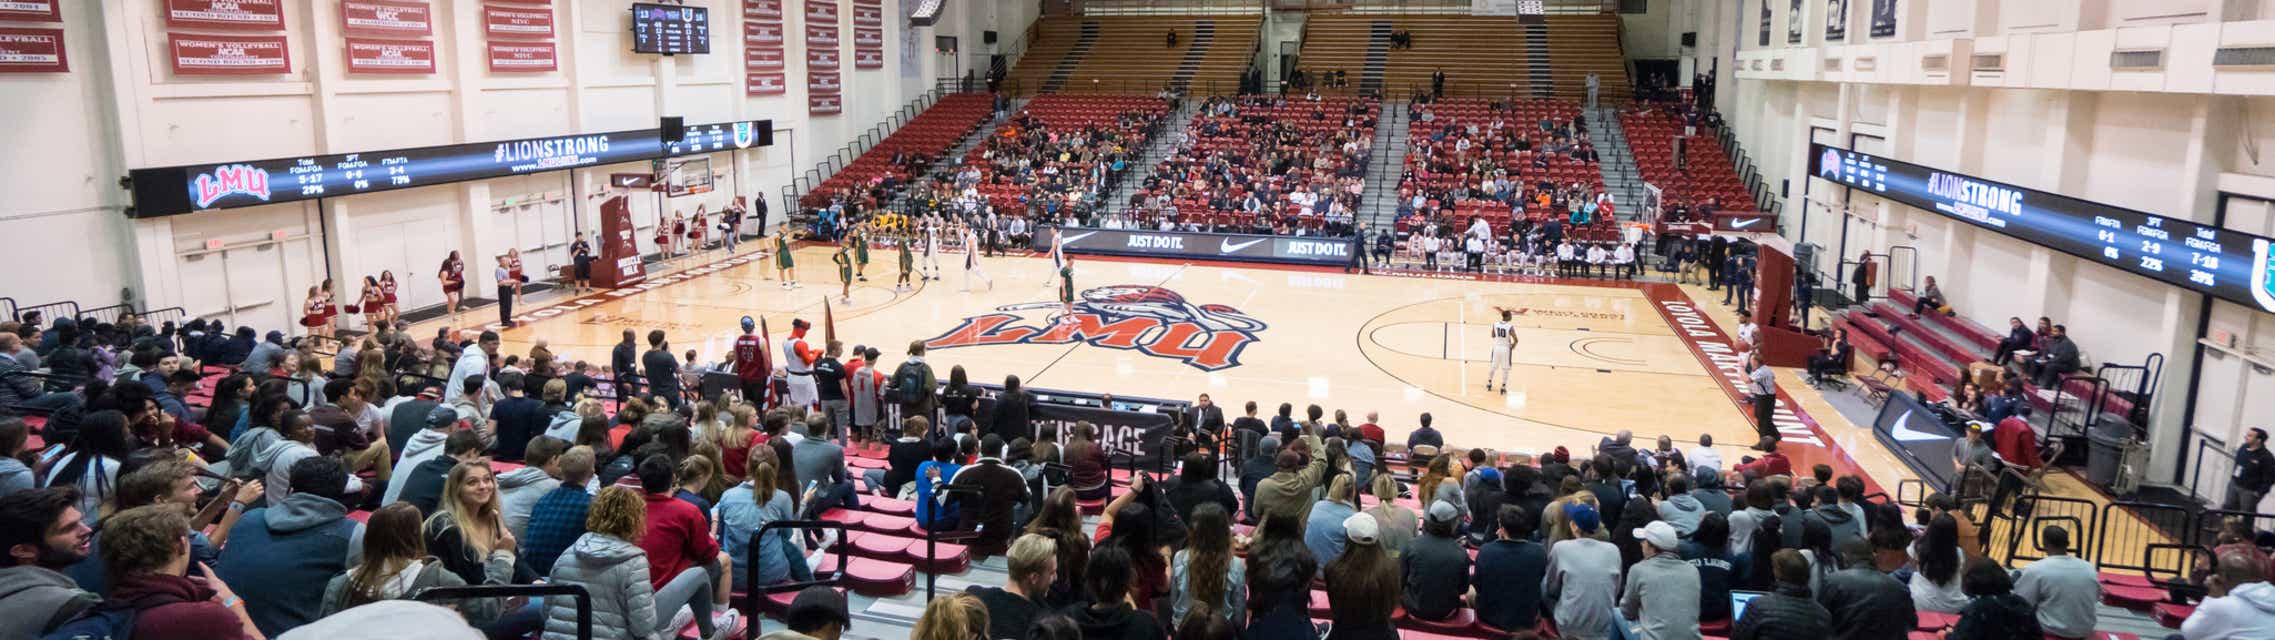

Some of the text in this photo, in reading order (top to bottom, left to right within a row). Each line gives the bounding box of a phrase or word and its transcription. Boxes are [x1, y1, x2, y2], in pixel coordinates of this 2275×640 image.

[179, 40, 225, 49] WOMEN'S
[217, 47, 246, 56] NCAA
[495, 135, 609, 163] #LIONSTRONG
[194, 163, 271, 208] LMU
[298, 174, 323, 184] 5-17
[354, 180, 369, 189] 0%
[391, 175, 411, 185] 75%
[302, 185, 324, 195] 29%
[1927, 172, 2023, 216] #LIONSTRONG
[2146, 216, 2163, 227] 3PT
[2196, 226, 2216, 240] Total
[1127, 234, 1184, 250] JUST DO IT.
[1287, 241, 1348, 257] JUST DO IT.
[2141, 240, 2161, 254] 2-9
[2140, 255, 2164, 272] 22%
[1660, 300, 1718, 337] LOYOLA
[1497, 327, 1507, 338] 10
[923, 312, 1262, 374] LMU
